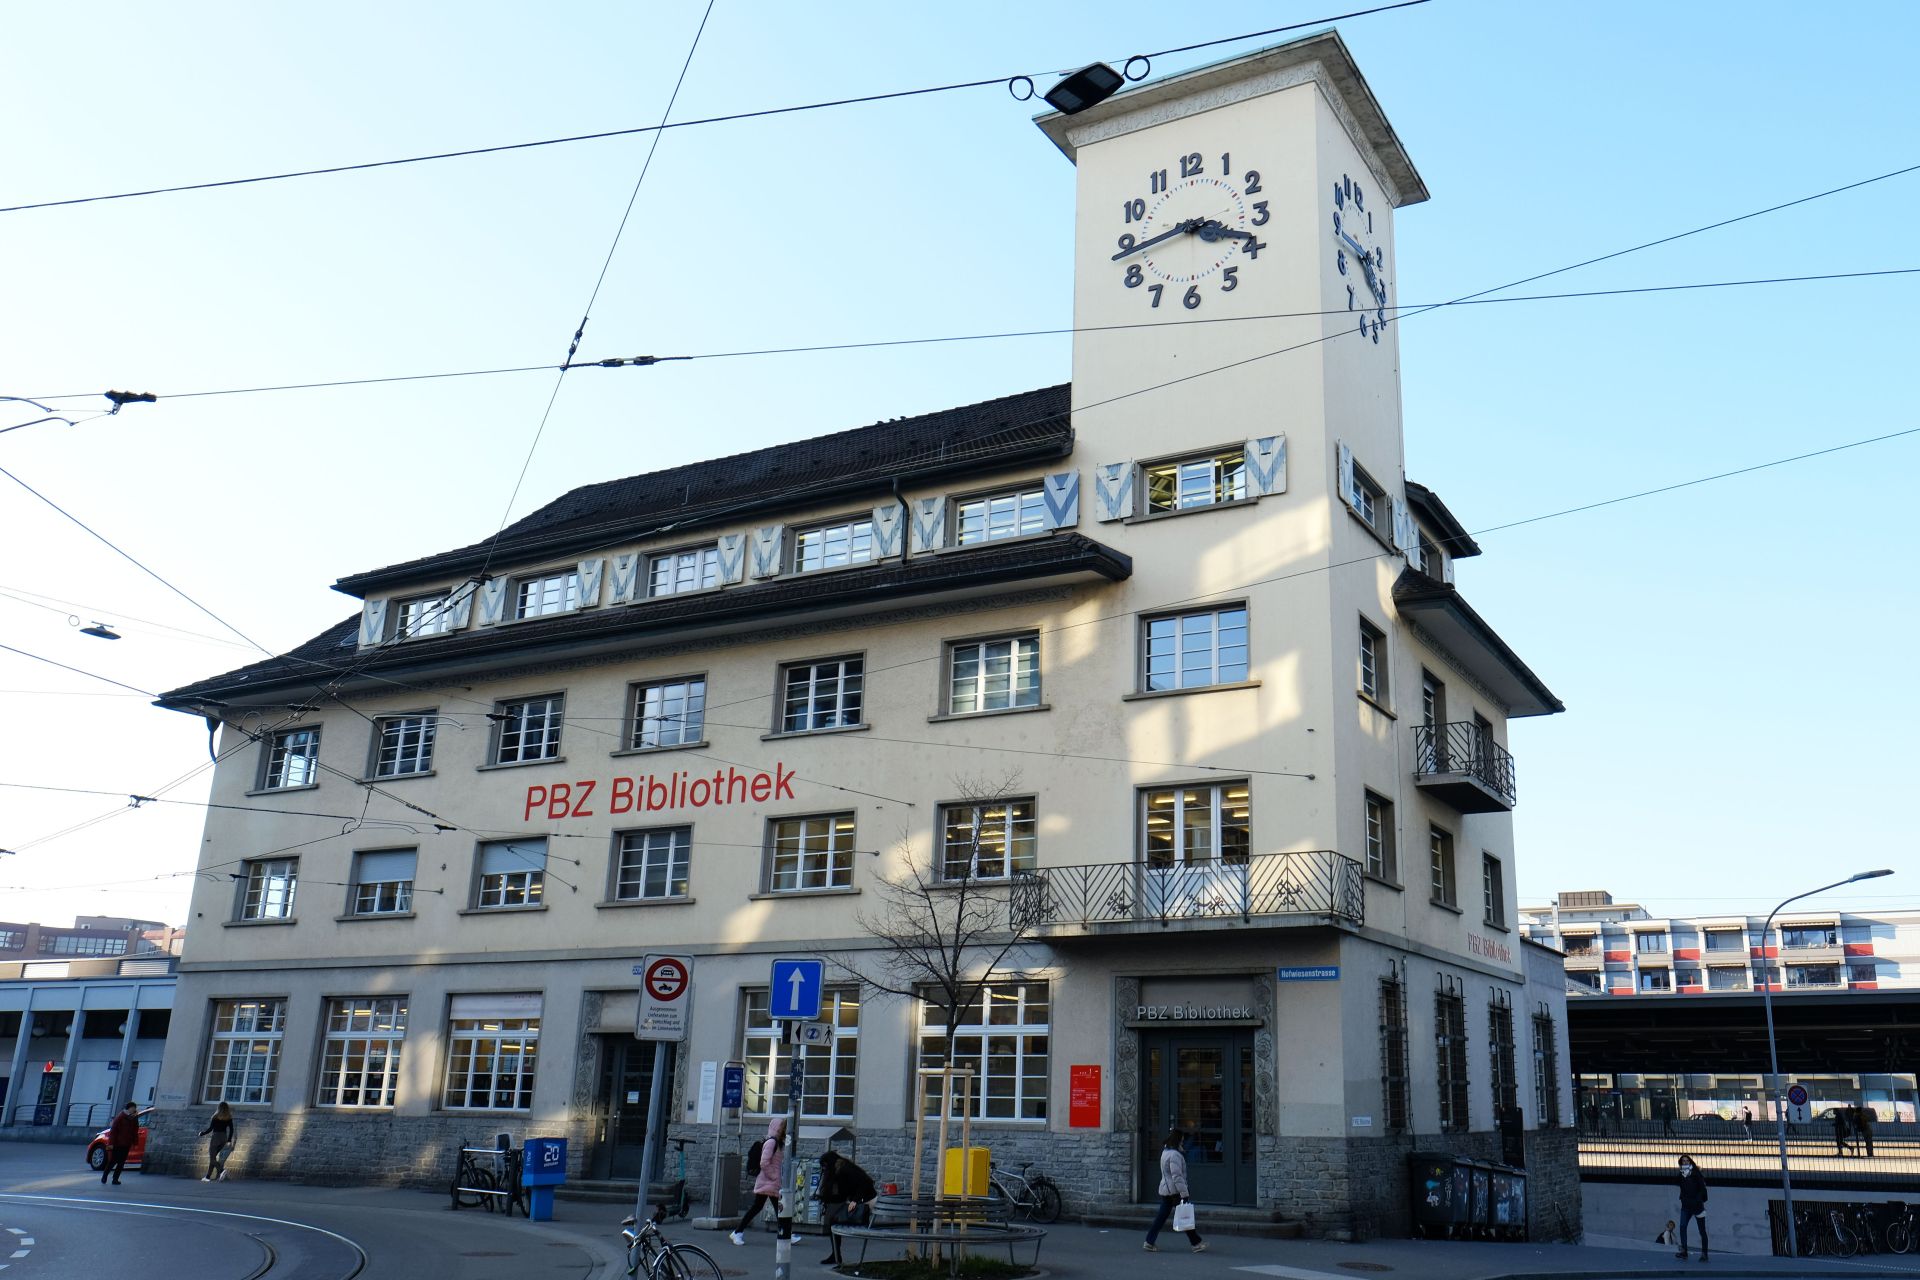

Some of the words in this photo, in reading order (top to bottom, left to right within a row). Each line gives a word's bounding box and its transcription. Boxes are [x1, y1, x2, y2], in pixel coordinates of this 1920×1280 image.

[1180, 152, 1203, 178] 12
[1221, 152, 1230, 175] 1
[1150, 168, 1167, 194] 11
[1244, 170, 1262, 195] 2
[1334, 182, 1344, 210] 10
[1354, 182, 1364, 212] 12
[1124, 198, 1146, 223] 10
[1251, 200, 1270, 226] 3
[1368, 212, 1372, 234] 1
[1334, 212, 1342, 236] 9
[1118, 233, 1136, 253] 9
[1242, 233, 1266, 259] 4
[1338, 249, 1346, 276] 8
[1376, 246, 1383, 272] 2
[1124, 264, 1144, 288] 8
[1221, 266, 1238, 291] 5
[1148, 283, 1164, 308] 7
[1182, 285, 1201, 309] 6
[1346, 285, 1354, 311] 7
[1360, 314, 1368, 338] 6
[1372, 320, 1378, 344] 5
[524, 780, 596, 822] PBZ
[610, 762, 796, 814] Bibliothek
[1281, 968, 1336, 978] Hofwiesenstrasse
[1137, 1006, 1168, 1020] PBZ
[1174, 1004, 1251, 1020] Bibliothek
[544, 1144, 560, 1162] 20
